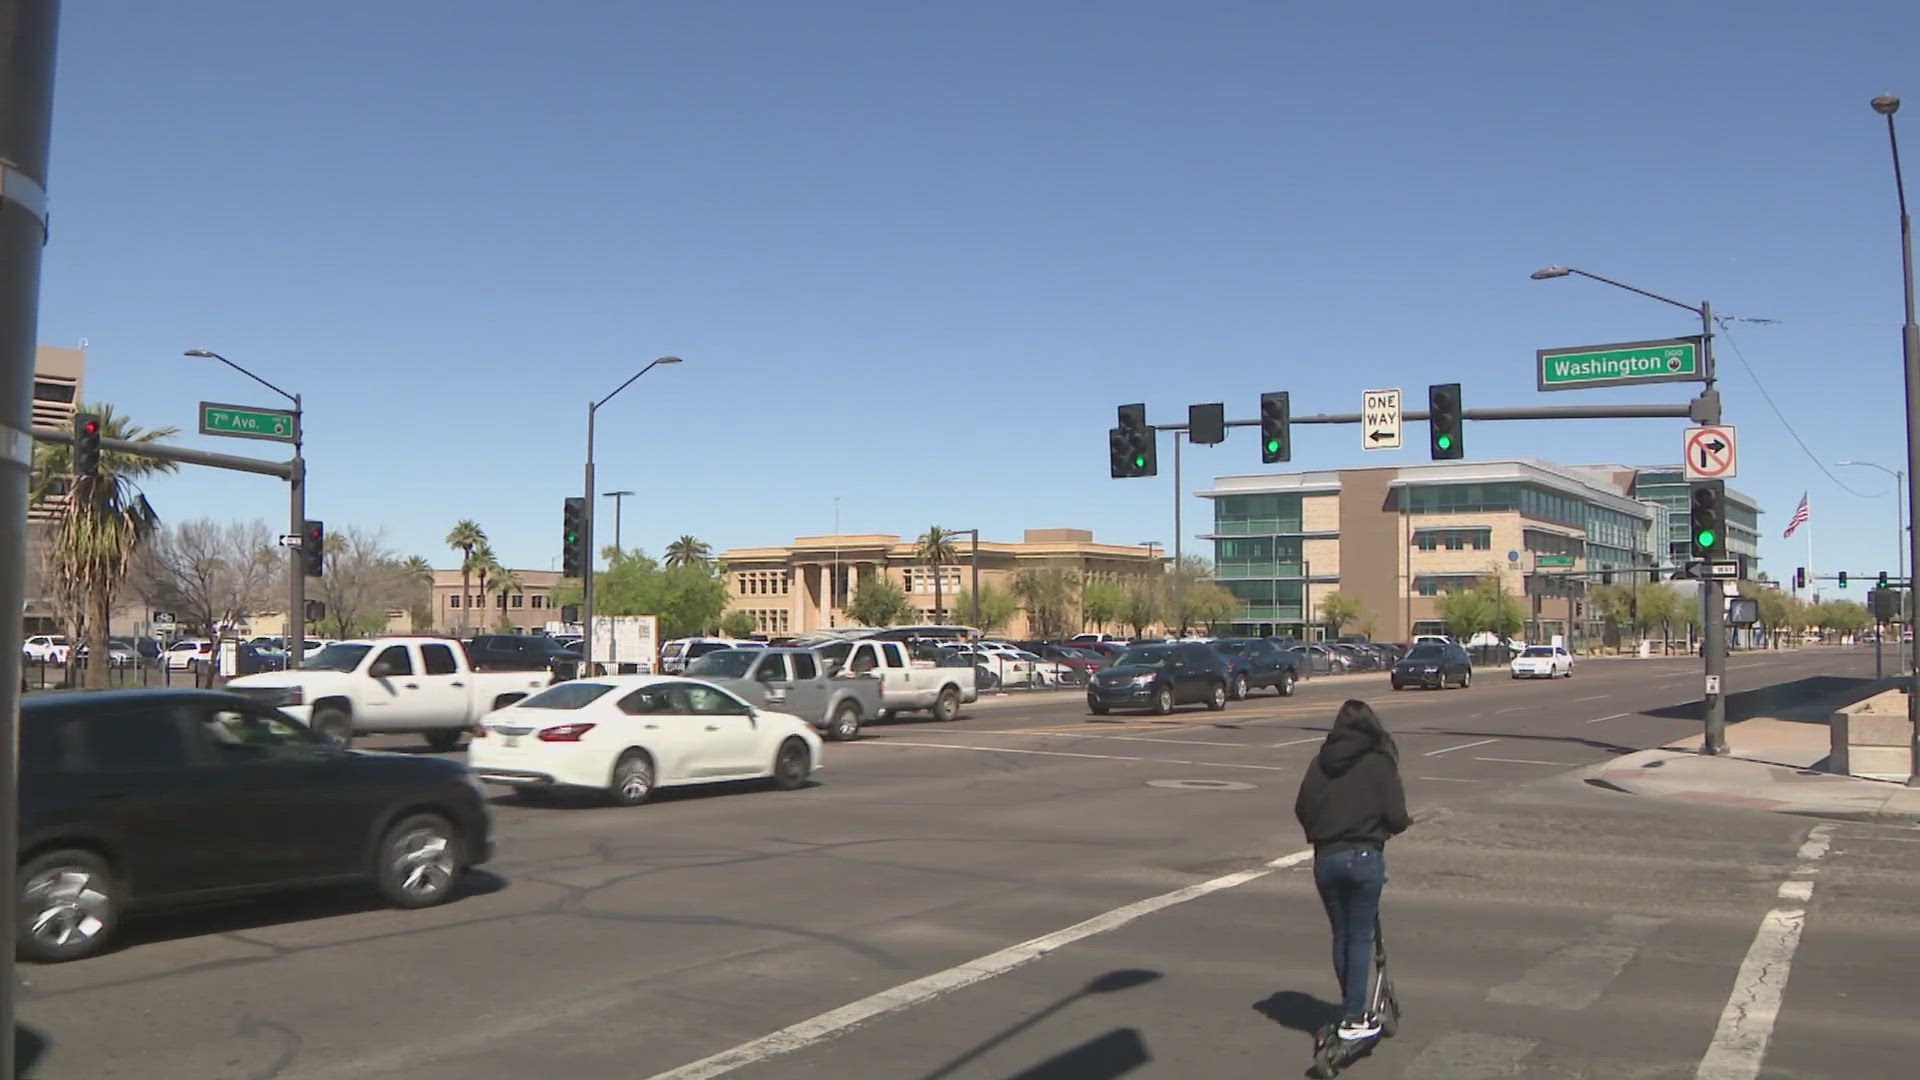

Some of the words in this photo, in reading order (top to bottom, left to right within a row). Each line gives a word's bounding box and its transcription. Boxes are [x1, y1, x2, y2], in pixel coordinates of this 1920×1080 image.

[1555, 357, 1661, 376] Washington
[1368, 396, 1395, 409] ONE
[232, 415, 259, 429] Ave.
[1367, 412, 1396, 426] WAY
